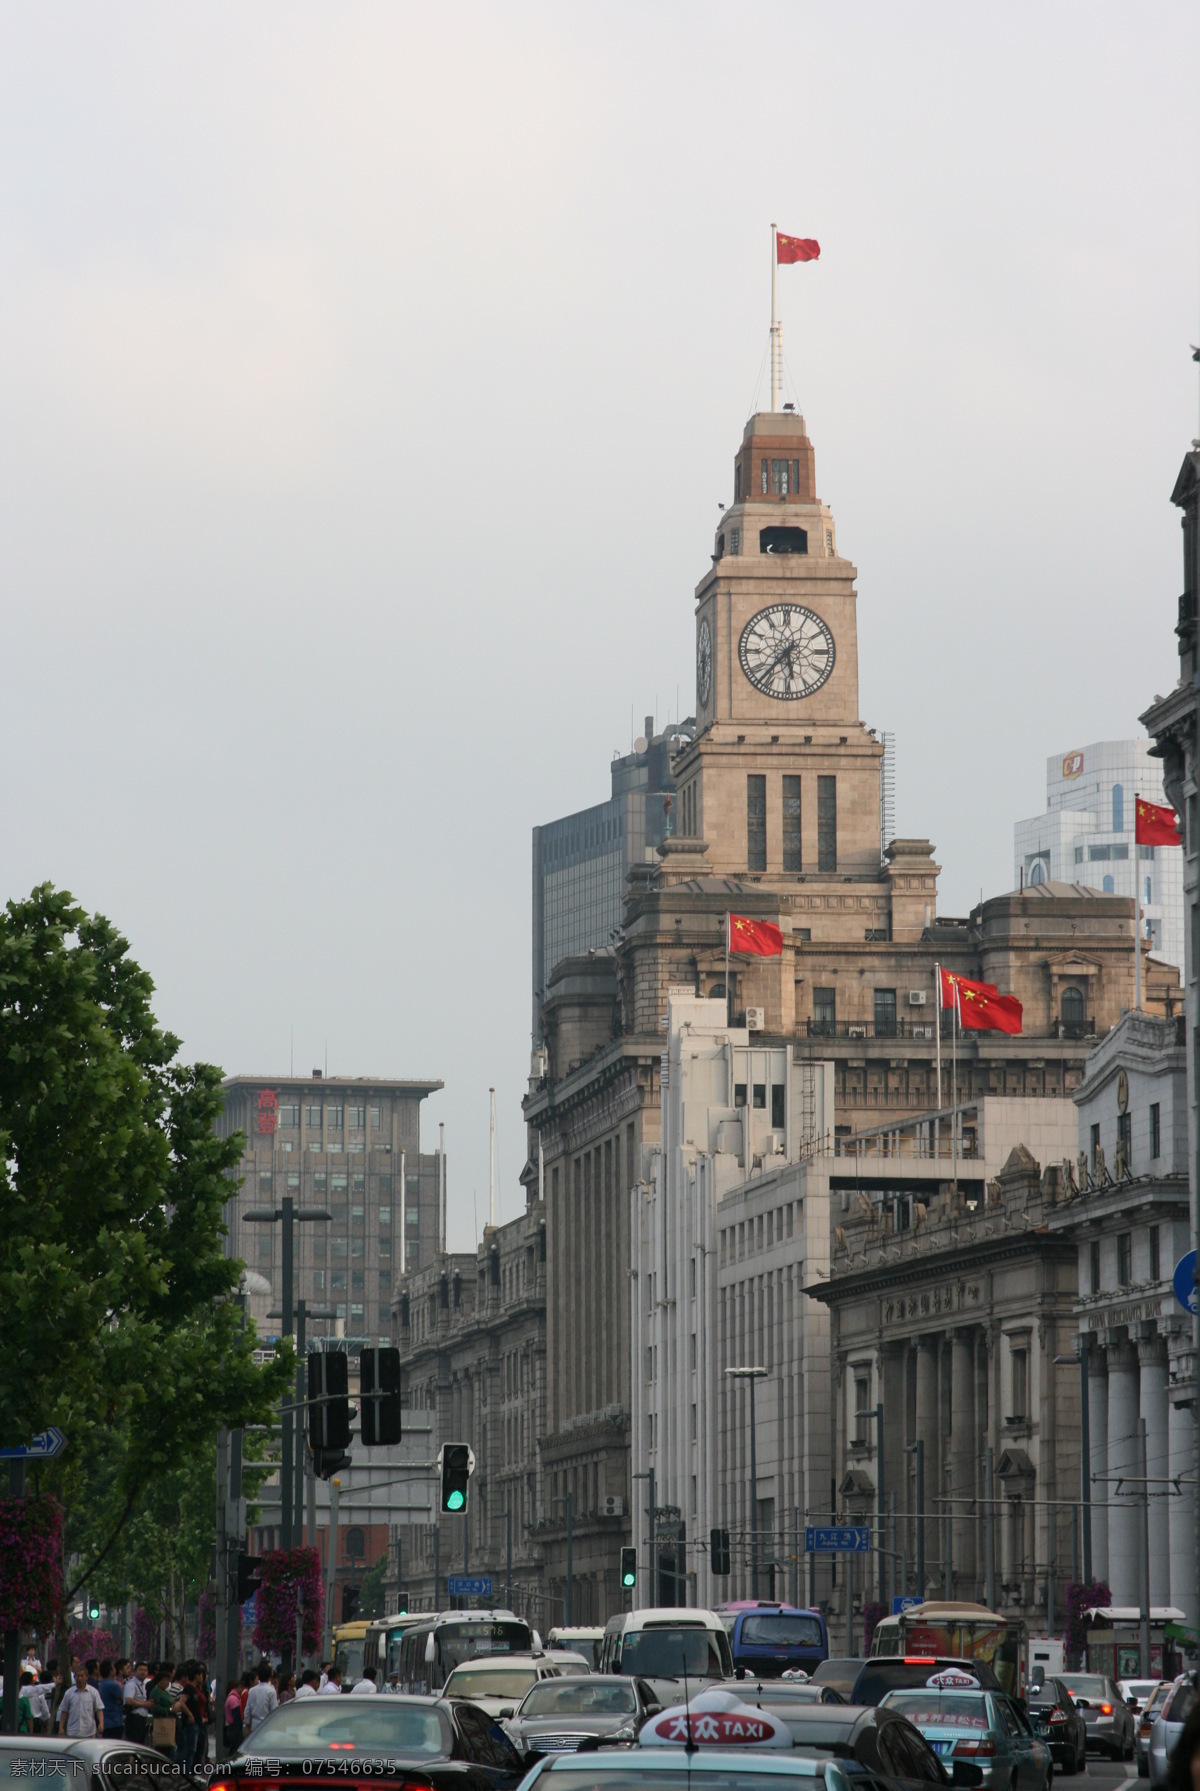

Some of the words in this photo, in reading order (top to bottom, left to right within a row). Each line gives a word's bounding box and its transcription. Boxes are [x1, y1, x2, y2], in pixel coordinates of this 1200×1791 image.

[257, 1088, 278, 1135] 高登
[669, 1715, 719, 1740] 大众
[723, 1721, 763, 1738] TAXI
